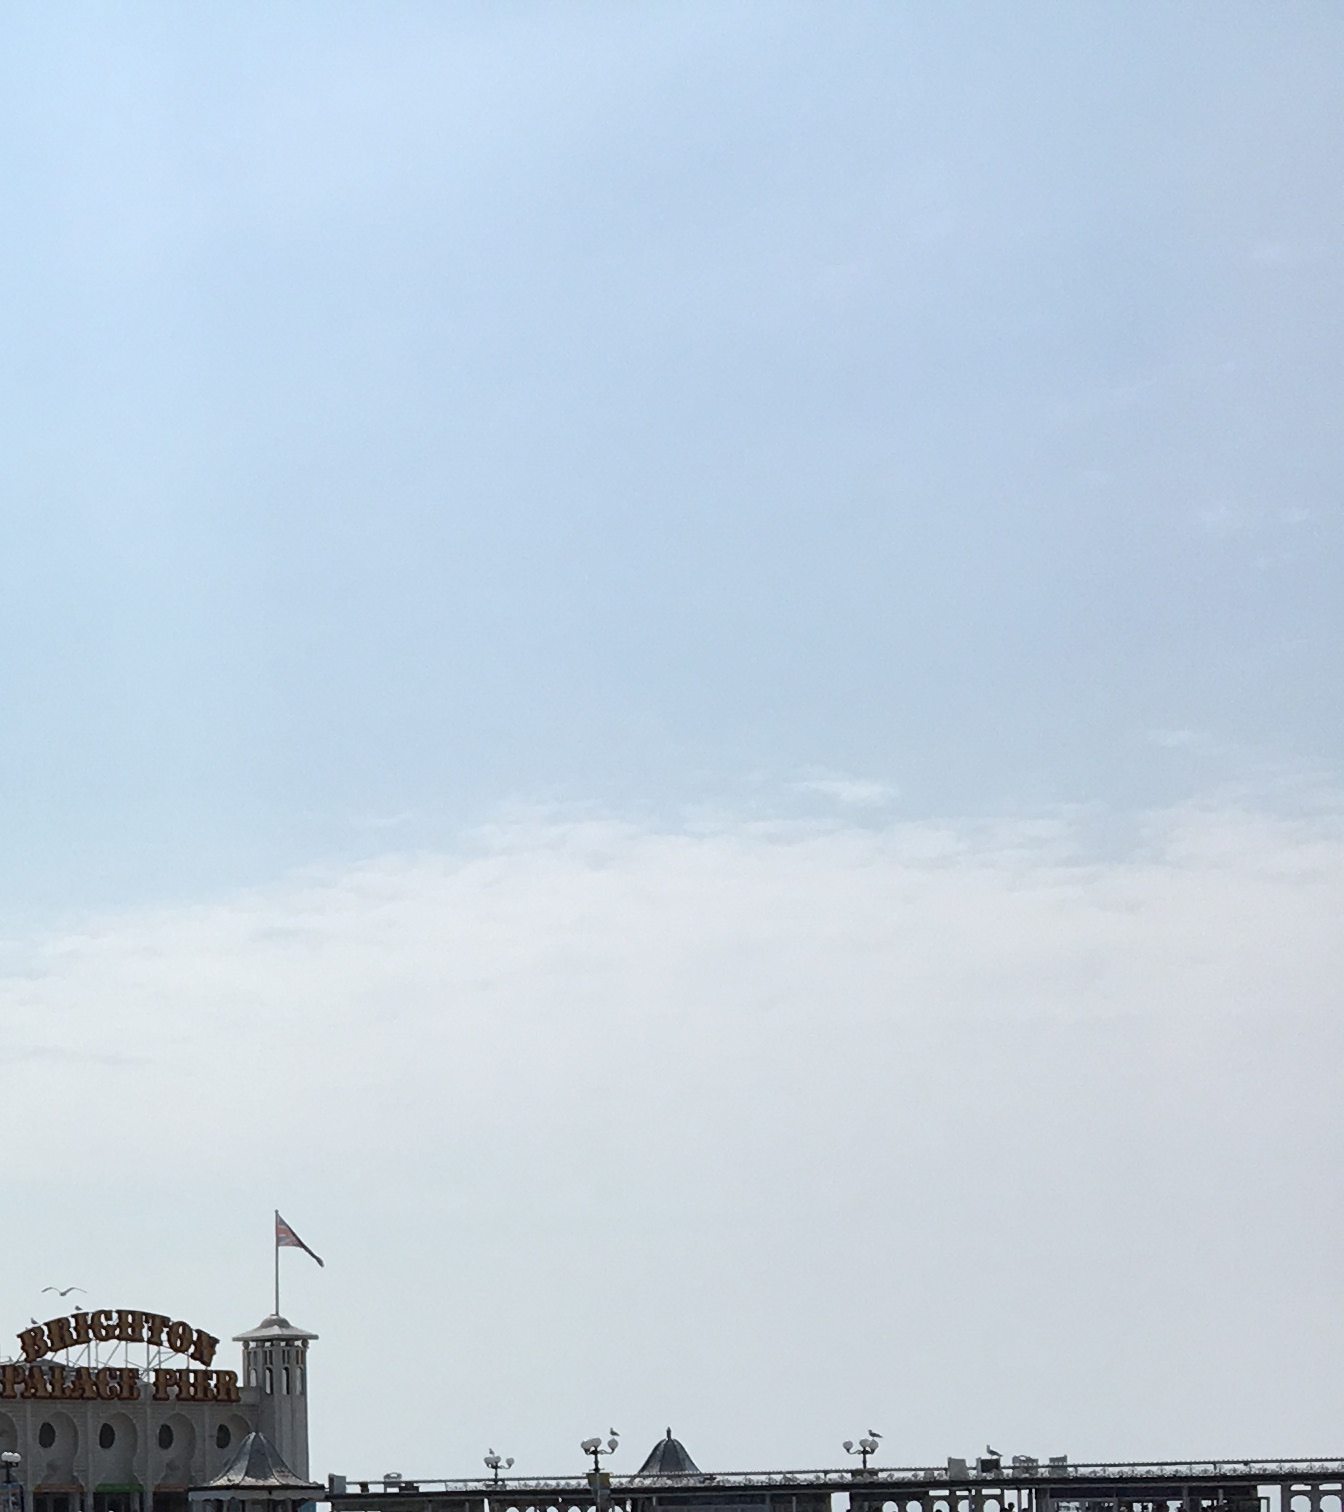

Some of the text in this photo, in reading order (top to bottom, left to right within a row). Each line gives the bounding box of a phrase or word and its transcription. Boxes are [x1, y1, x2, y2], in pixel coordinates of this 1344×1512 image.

[17, 1309, 220, 1367] BRIGHTON
[0, 1365, 241, 1402] PALACE PIER
